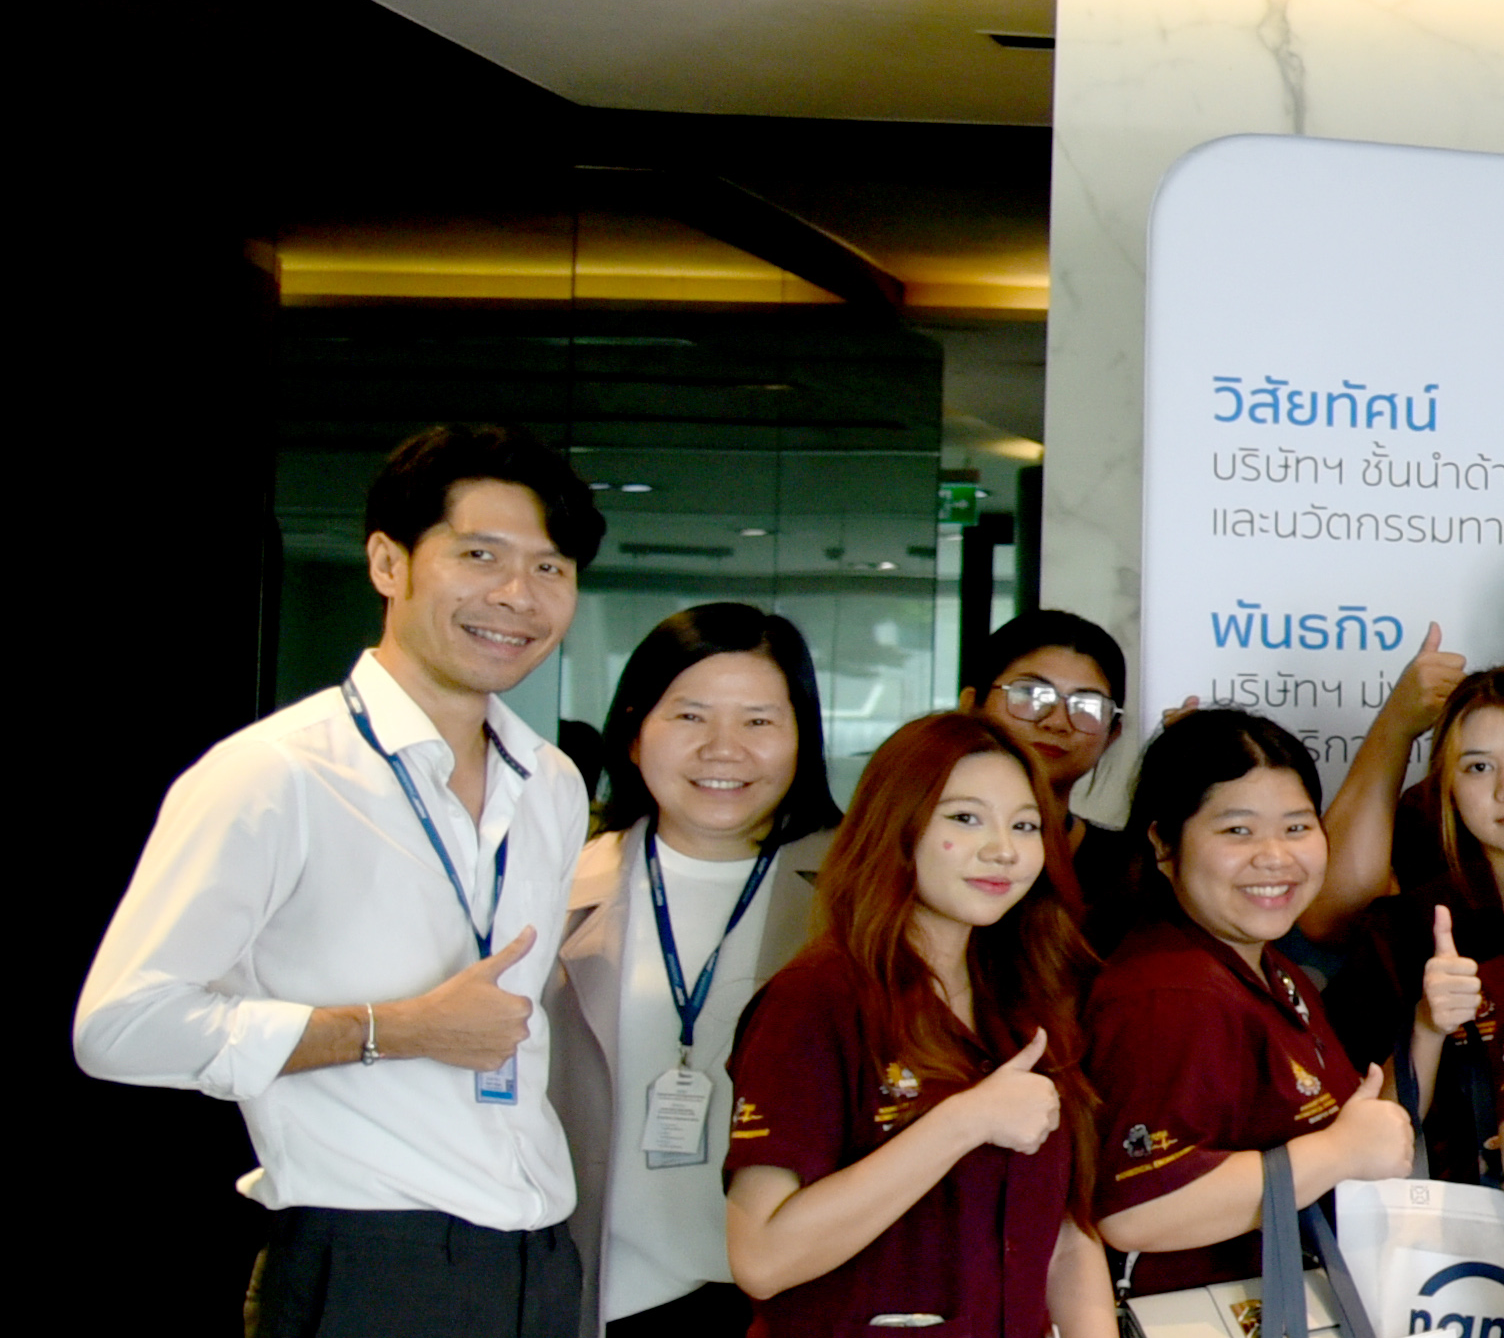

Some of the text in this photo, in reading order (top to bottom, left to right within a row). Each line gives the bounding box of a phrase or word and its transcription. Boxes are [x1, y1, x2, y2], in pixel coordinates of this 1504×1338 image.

[1213, 375, 1440, 432] วิสัยทัศน์
[1213, 444, 1344, 484] บริษัทฯ
[1211, 599, 1403, 651] พันธกิจ
